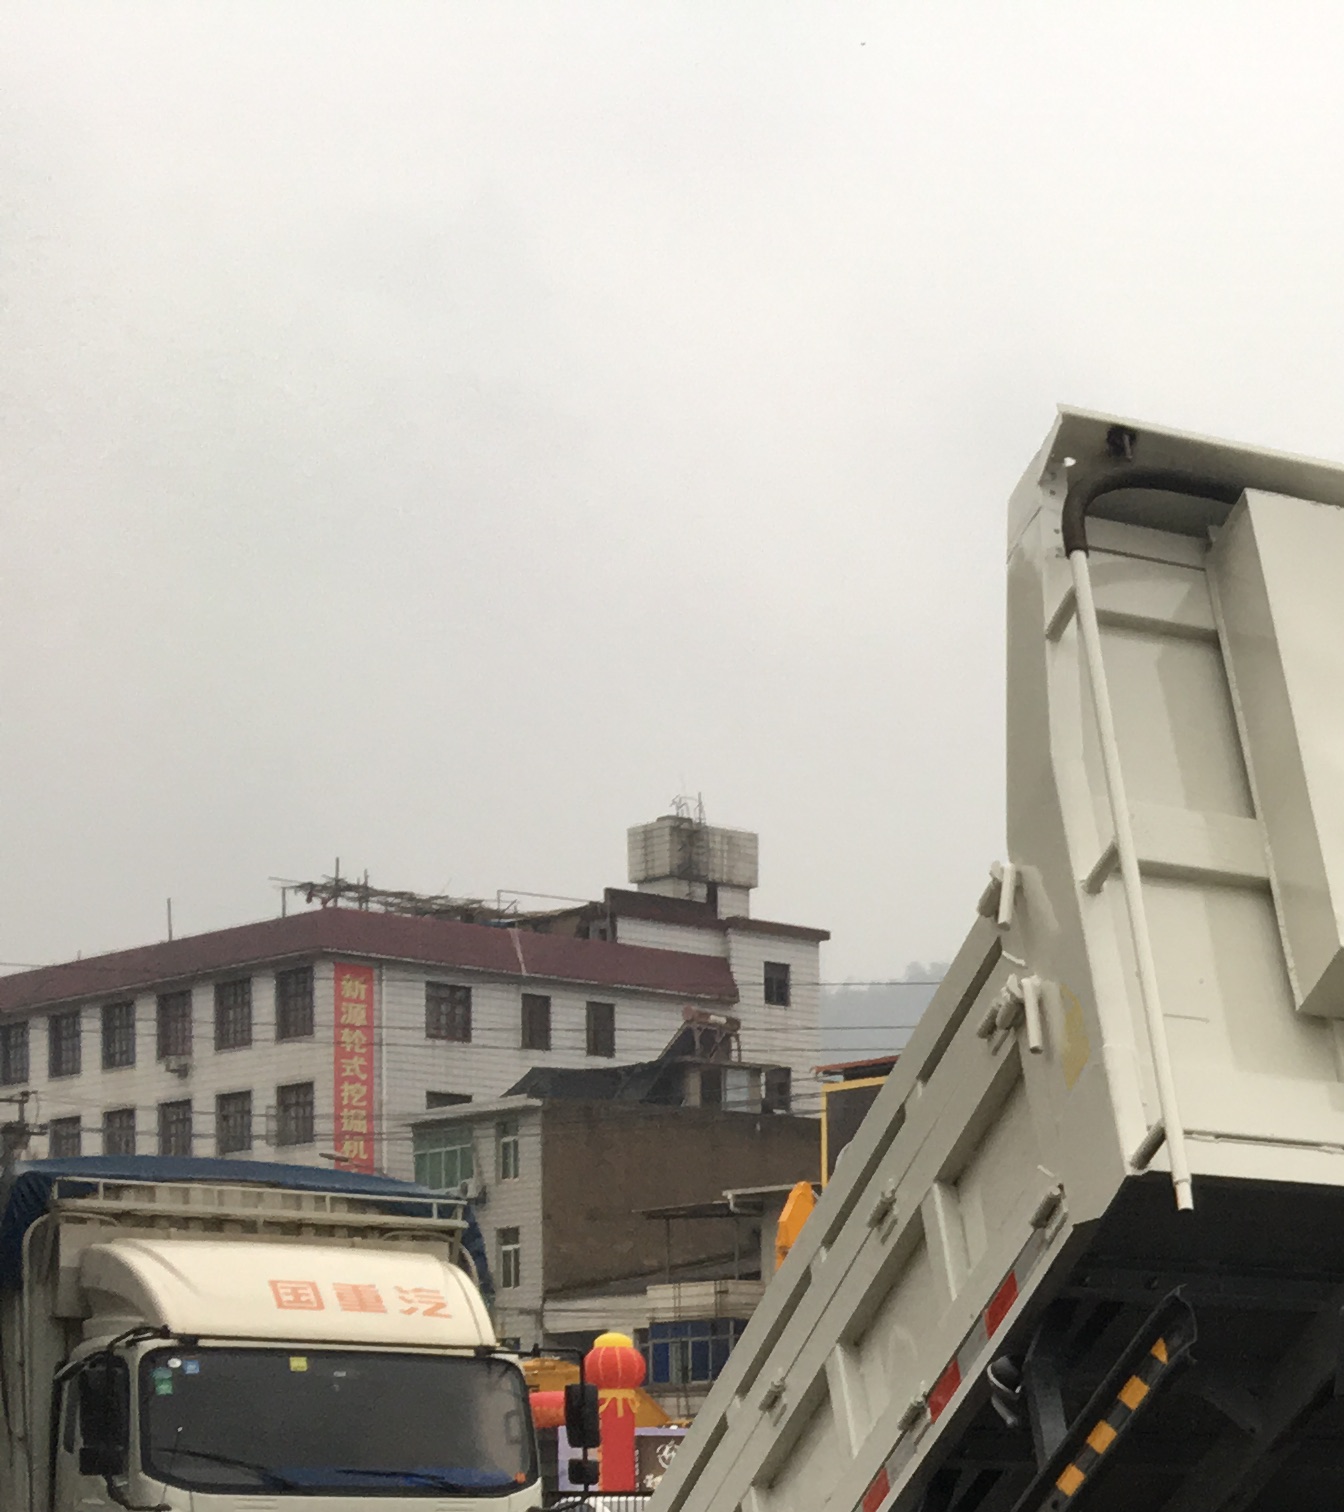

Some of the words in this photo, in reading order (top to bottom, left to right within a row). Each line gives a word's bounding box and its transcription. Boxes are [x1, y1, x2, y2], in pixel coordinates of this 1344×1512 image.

[340, 974, 368, 1174] 新源轮式挖掘机
[268, 1280, 453, 1319] 国重汽
